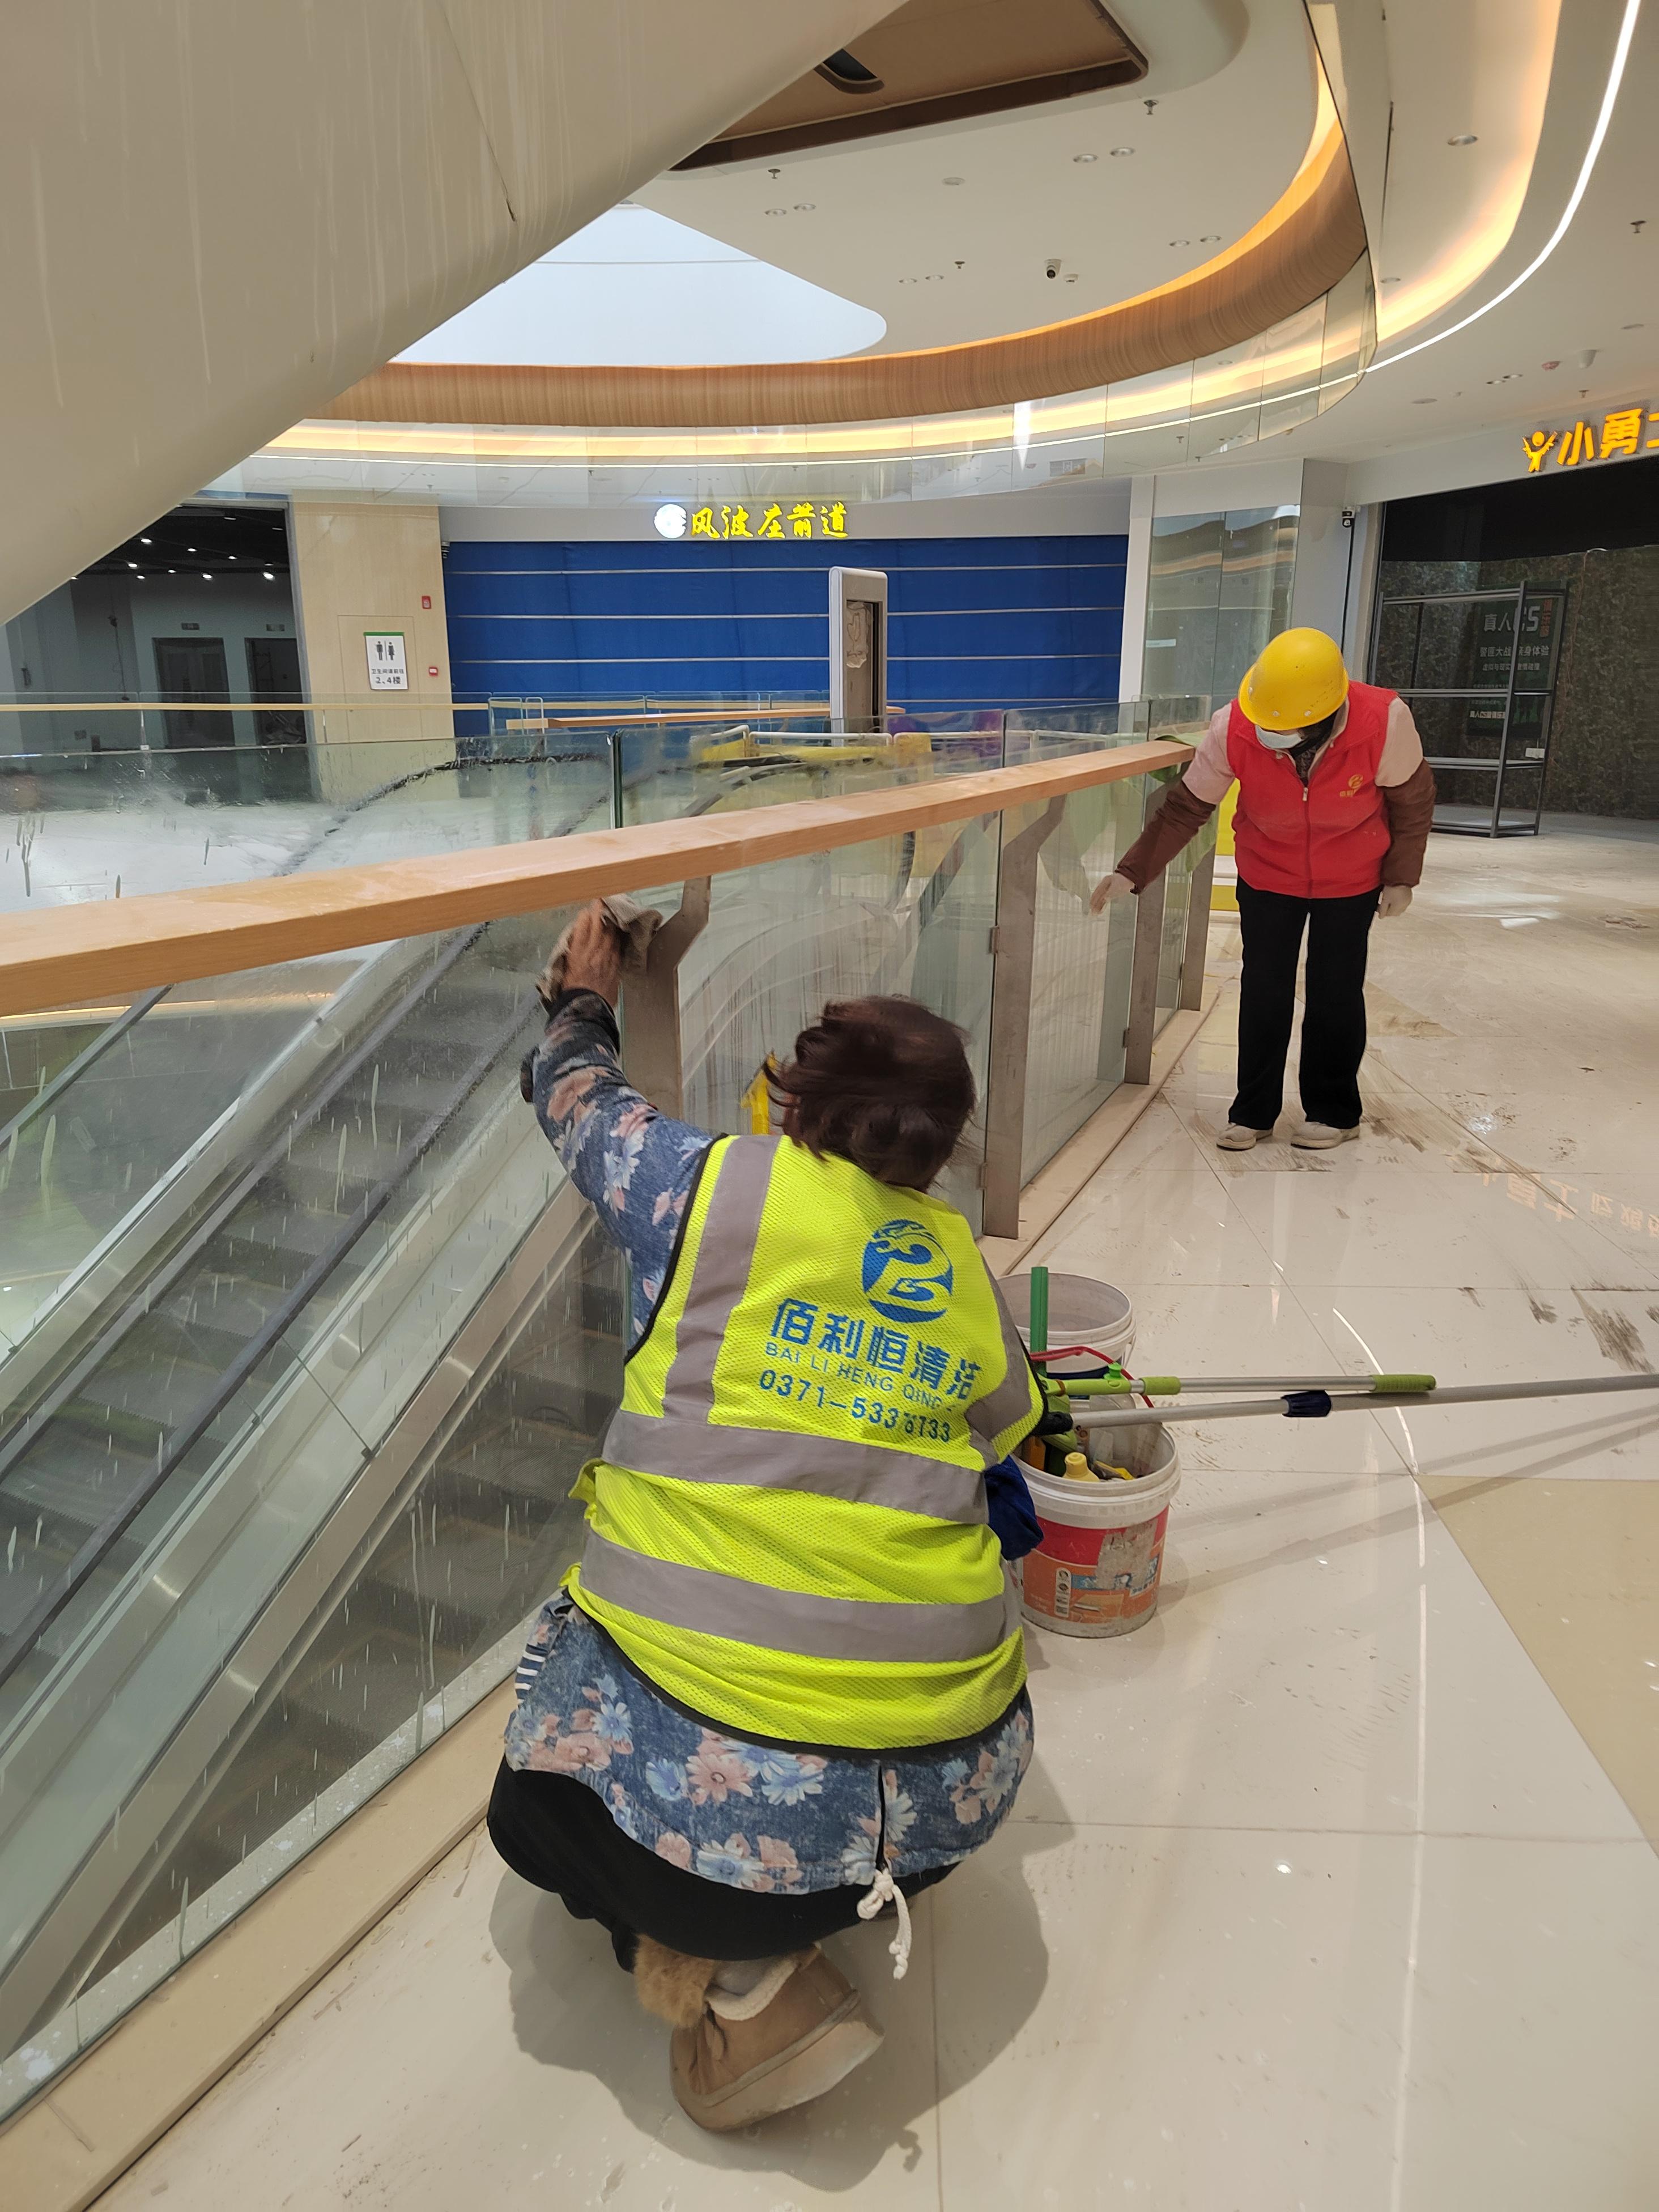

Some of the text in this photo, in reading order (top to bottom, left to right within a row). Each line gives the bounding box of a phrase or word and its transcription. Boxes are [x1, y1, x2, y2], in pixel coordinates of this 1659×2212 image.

[765, 1342, 800, 1364] BAI
[810, 1354, 829, 1373] LI
[837, 1362, 894, 1392] HENG
[770, 1298, 982, 1400] 佰利恒清洁
